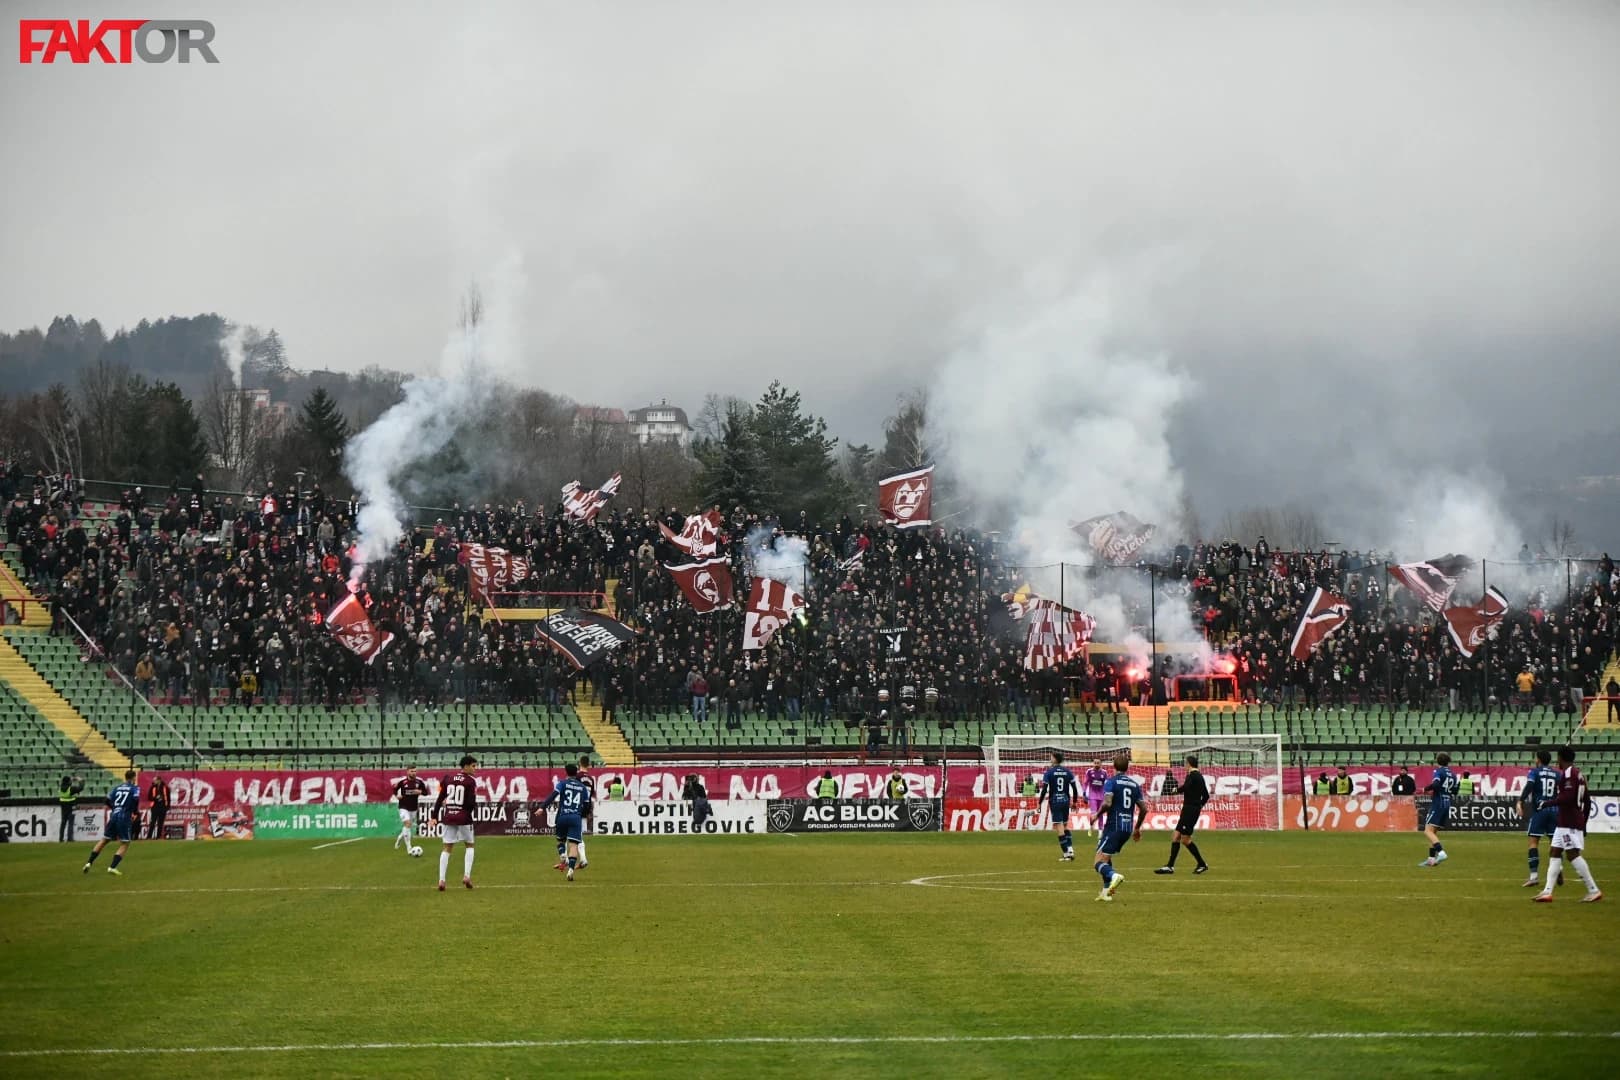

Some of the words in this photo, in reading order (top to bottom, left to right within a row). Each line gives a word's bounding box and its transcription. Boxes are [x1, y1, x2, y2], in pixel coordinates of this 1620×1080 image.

[234, 777, 368, 805] MALENA
[730, 774, 782, 800] NA
[1057, 777, 1065, 792] 9
[1442, 777, 1455, 793] 42
[1540, 778, 1556, 798] 18
[115, 791, 129, 806] 27
[446, 784, 465, 806] 20
[564, 789, 581, 808] 34
[1123, 788, 1132, 809] 6
[471, 804, 507, 822] LIDŽA
[803, 806, 834, 821] AC
[841, 805, 899, 821] BLOK
[598, 816, 755, 834] SALIHBEGOVIĆ
